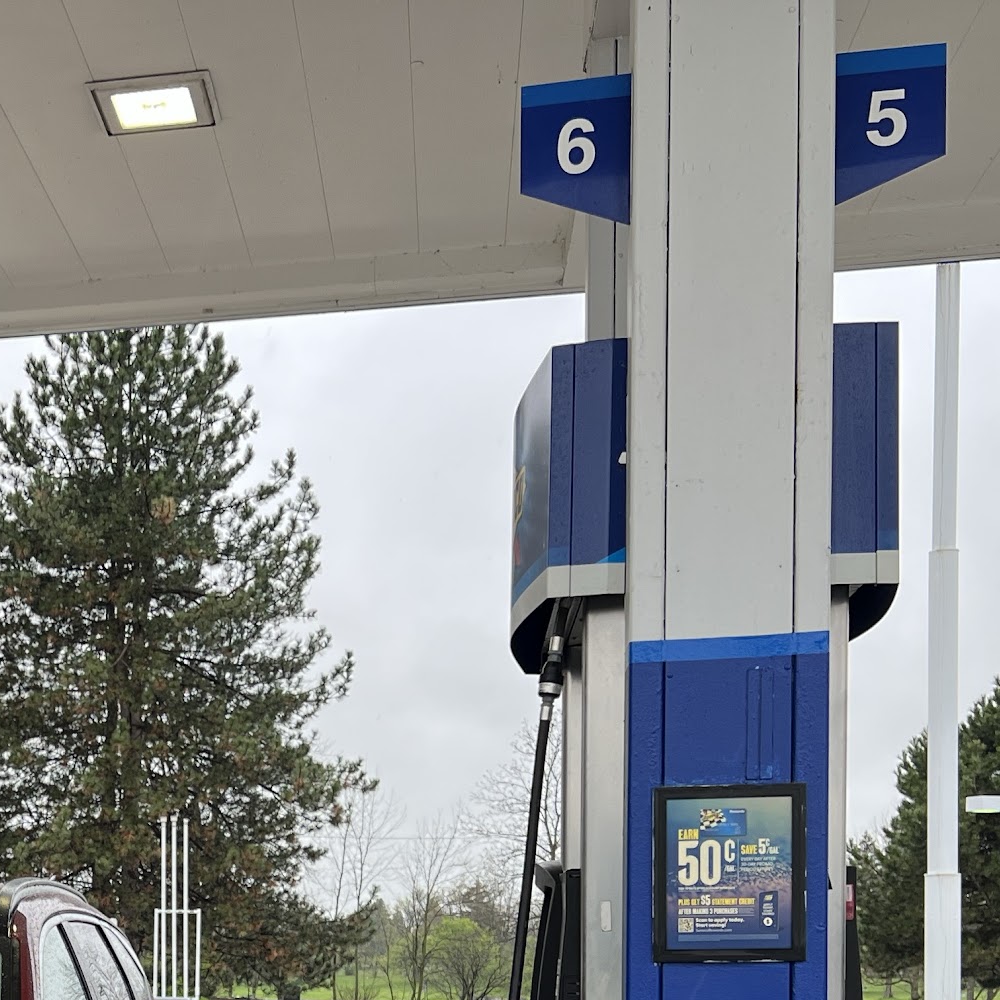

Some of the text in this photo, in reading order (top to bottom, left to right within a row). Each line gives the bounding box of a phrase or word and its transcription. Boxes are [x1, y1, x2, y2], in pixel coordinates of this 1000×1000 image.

[866, 88, 908, 147] 5
[557, 117, 596, 175] 6
[678, 828, 699, 839] EARN
[741, 844, 758, 855] SAVE
[700, 894, 711, 906] $5
